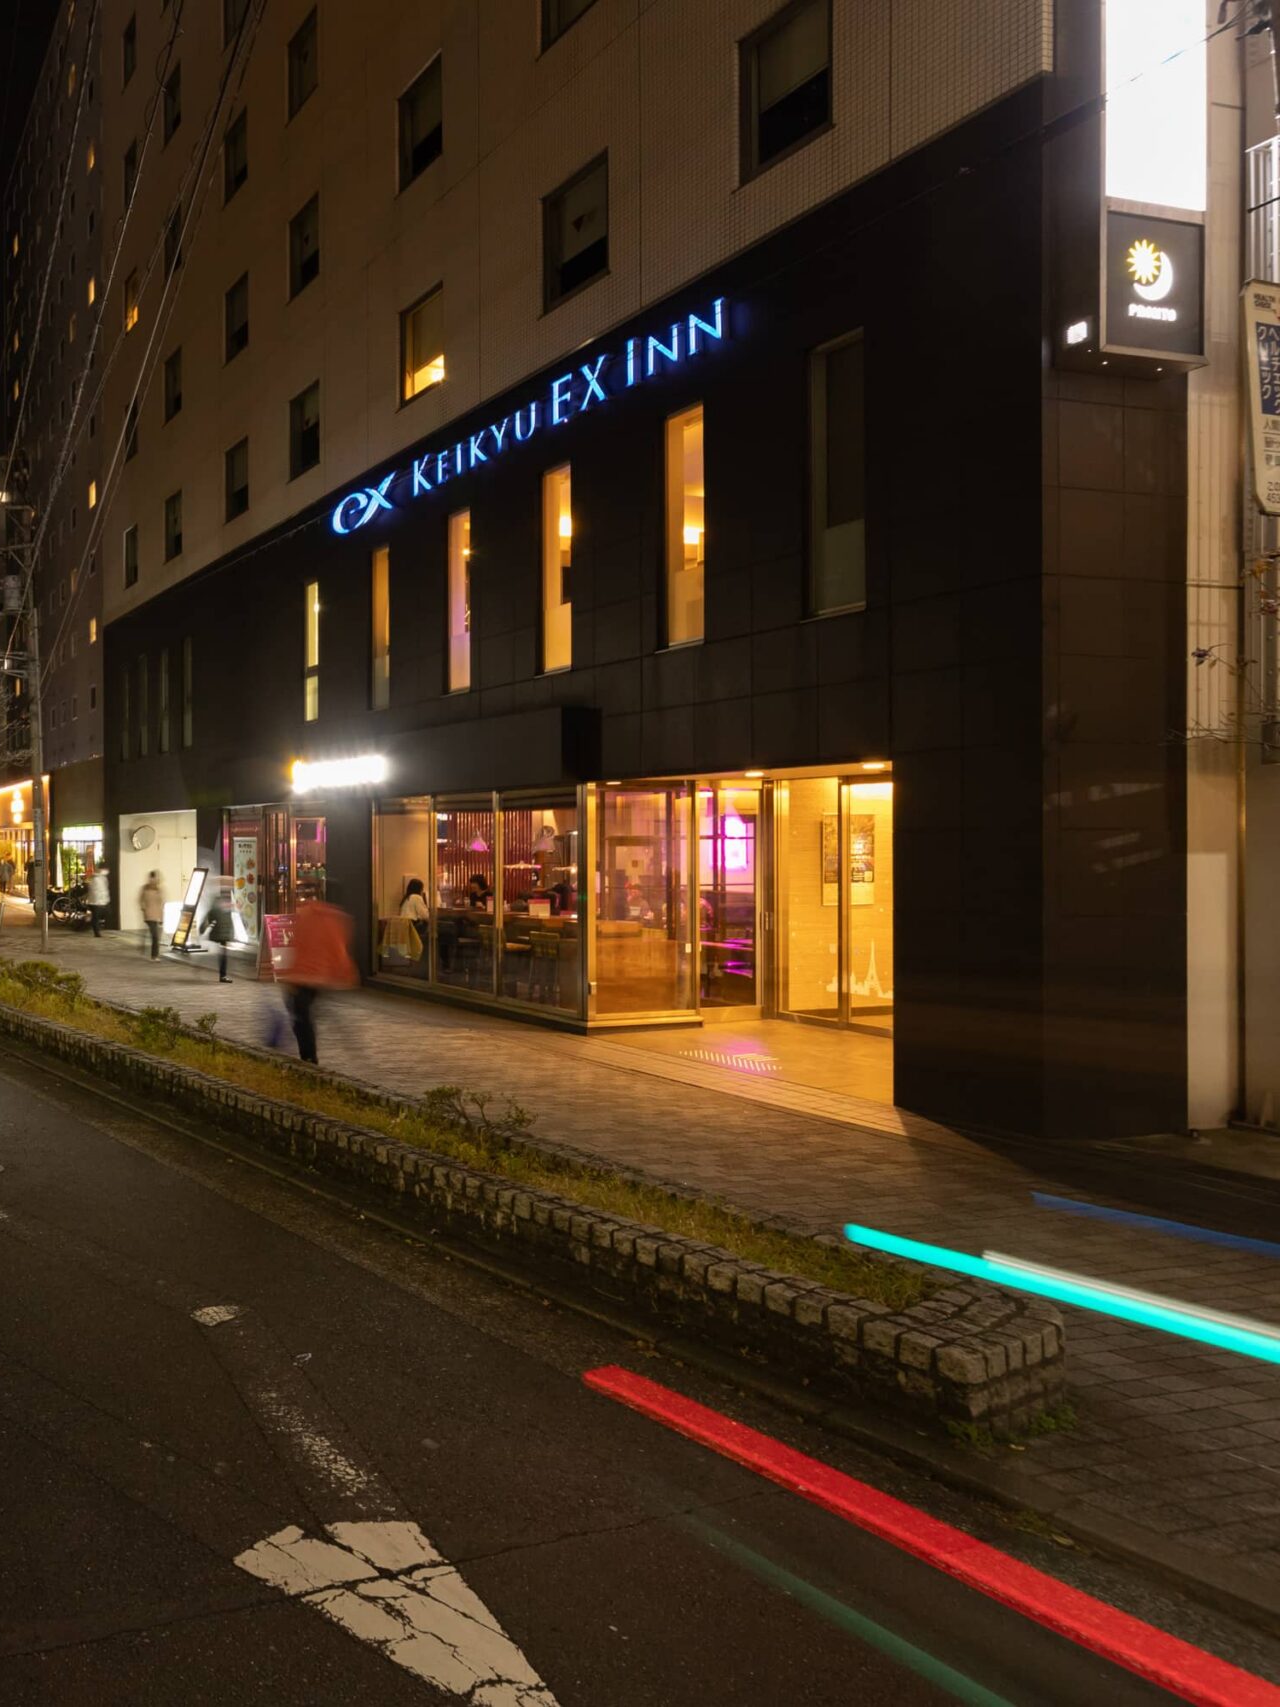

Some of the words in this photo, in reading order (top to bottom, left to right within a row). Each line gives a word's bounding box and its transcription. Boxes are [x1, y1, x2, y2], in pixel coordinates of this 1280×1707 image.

[412, 400, 538, 498] KEIKYU
[551, 353, 608, 424] EX
[627, 296, 727, 388] INN
